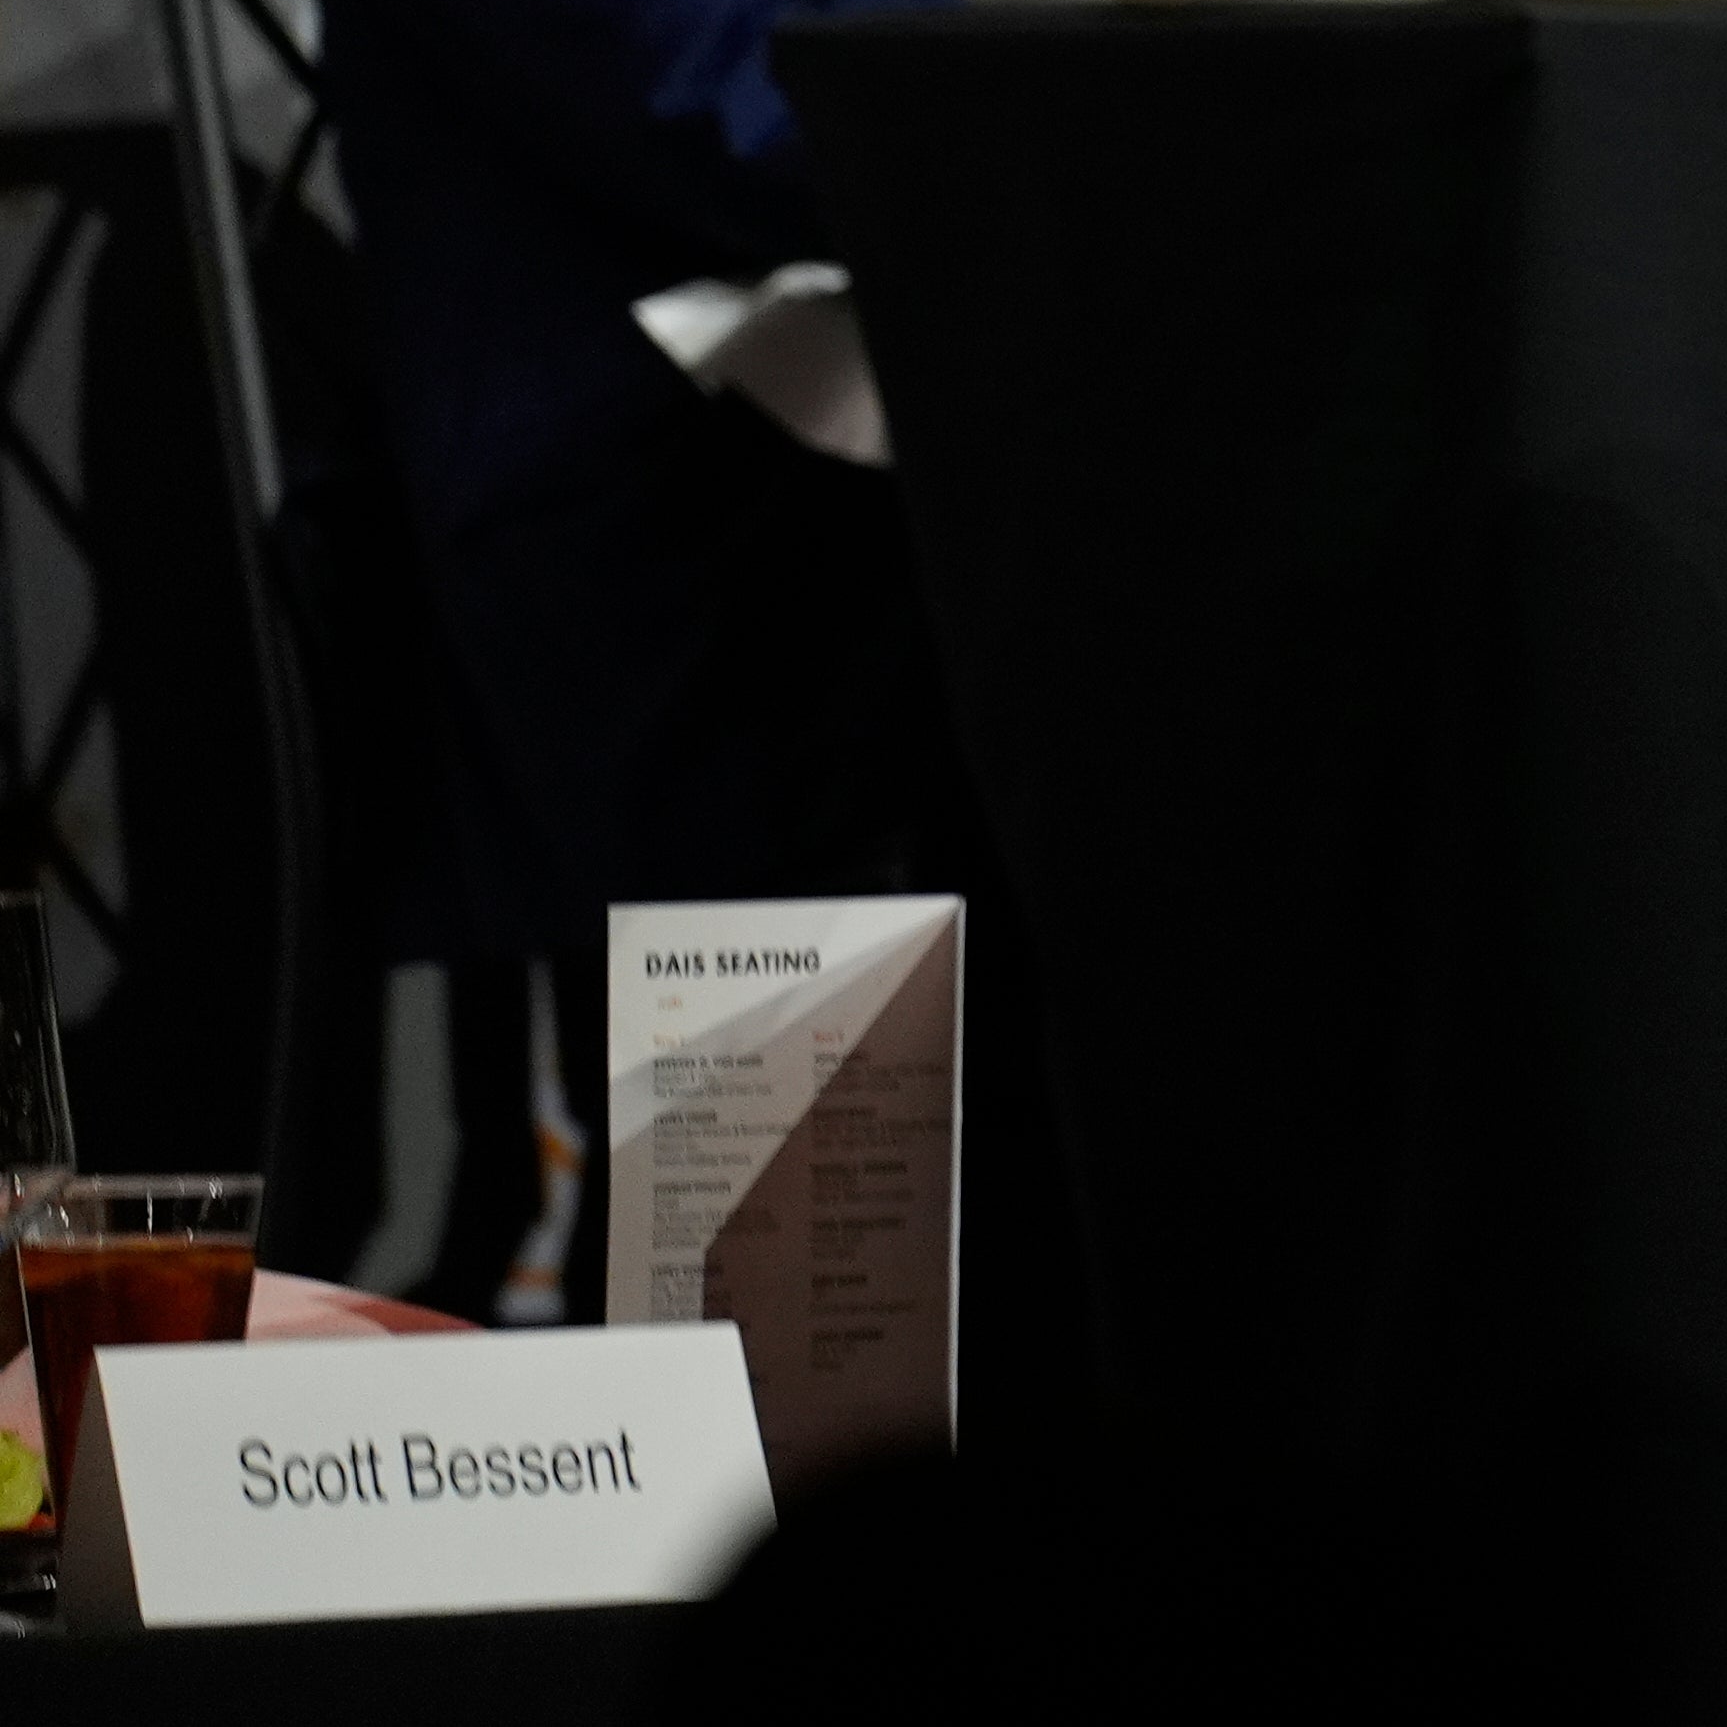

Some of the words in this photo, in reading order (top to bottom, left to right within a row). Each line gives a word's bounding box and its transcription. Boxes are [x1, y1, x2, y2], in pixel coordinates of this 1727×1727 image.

[644, 947, 705, 979] DAIS
[716, 944, 822, 977] SEATING
[237, 1436, 389, 1512] Scott
[401, 1425, 642, 1503] Bessent
